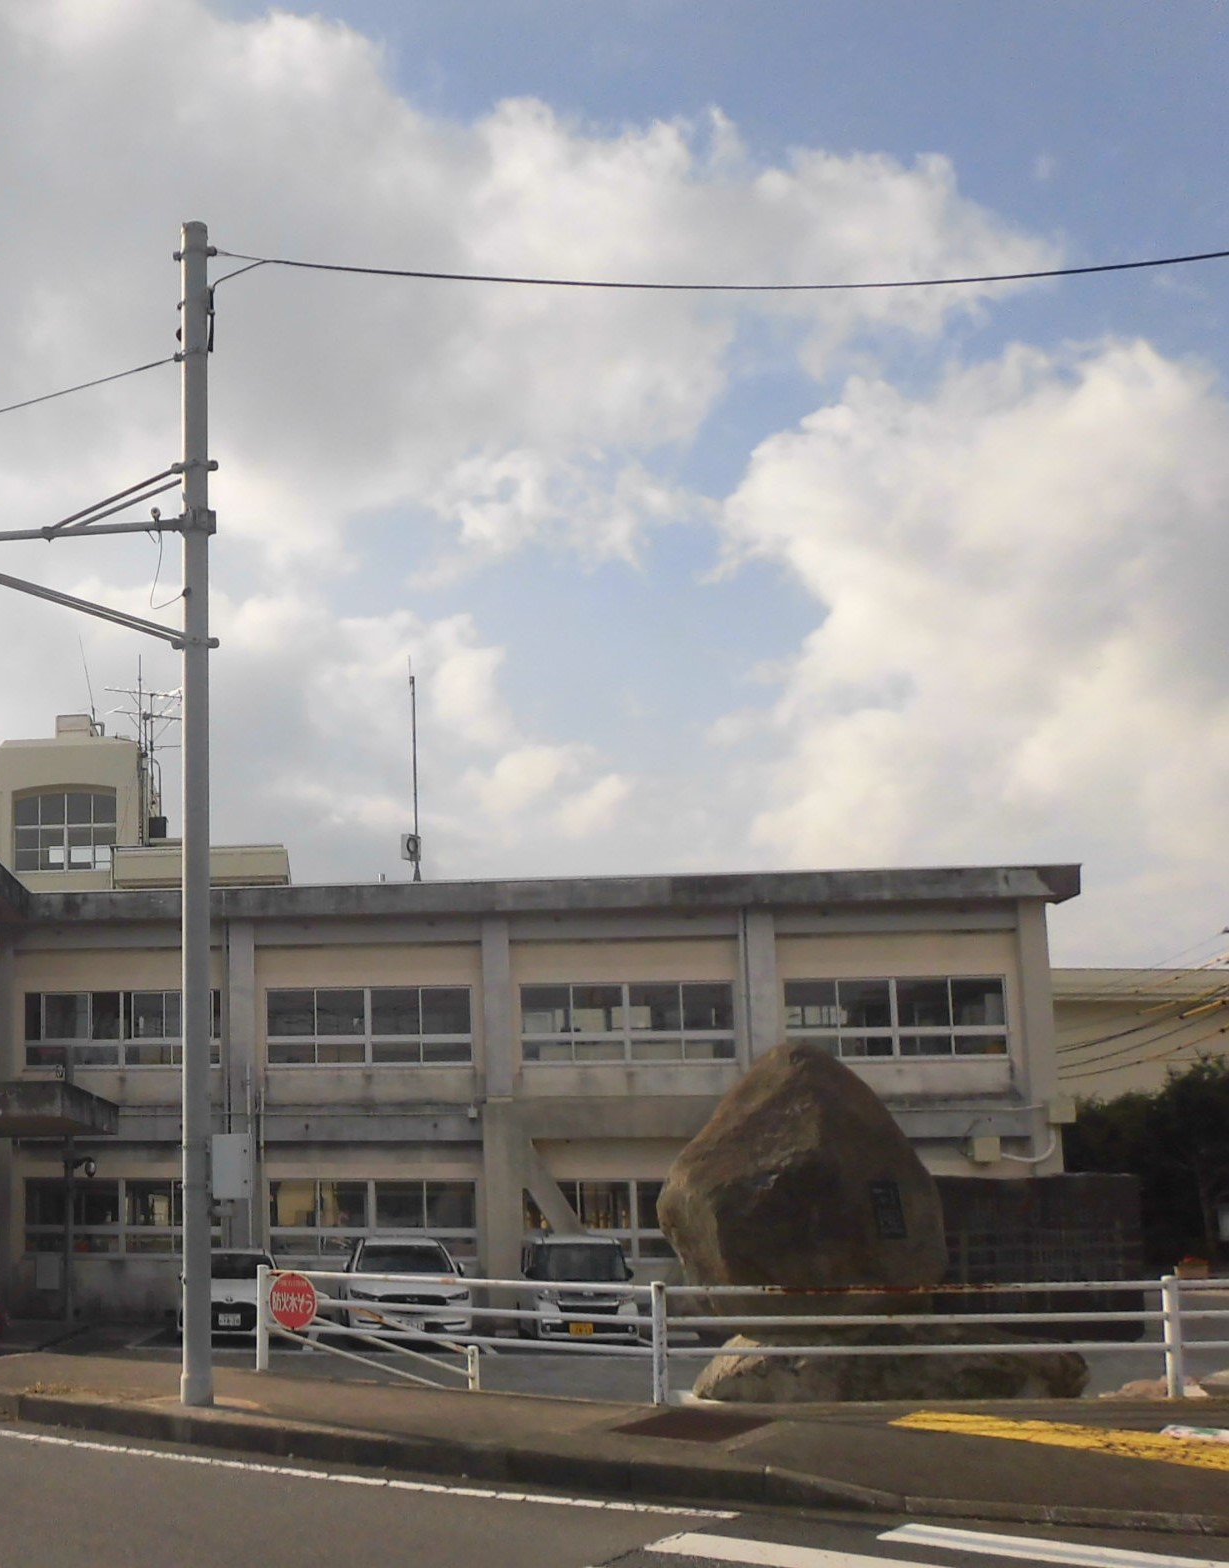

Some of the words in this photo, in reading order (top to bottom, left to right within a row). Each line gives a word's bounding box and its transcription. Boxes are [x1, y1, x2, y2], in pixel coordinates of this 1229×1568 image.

[272, 1291, 313, 1314] 防火水そう
